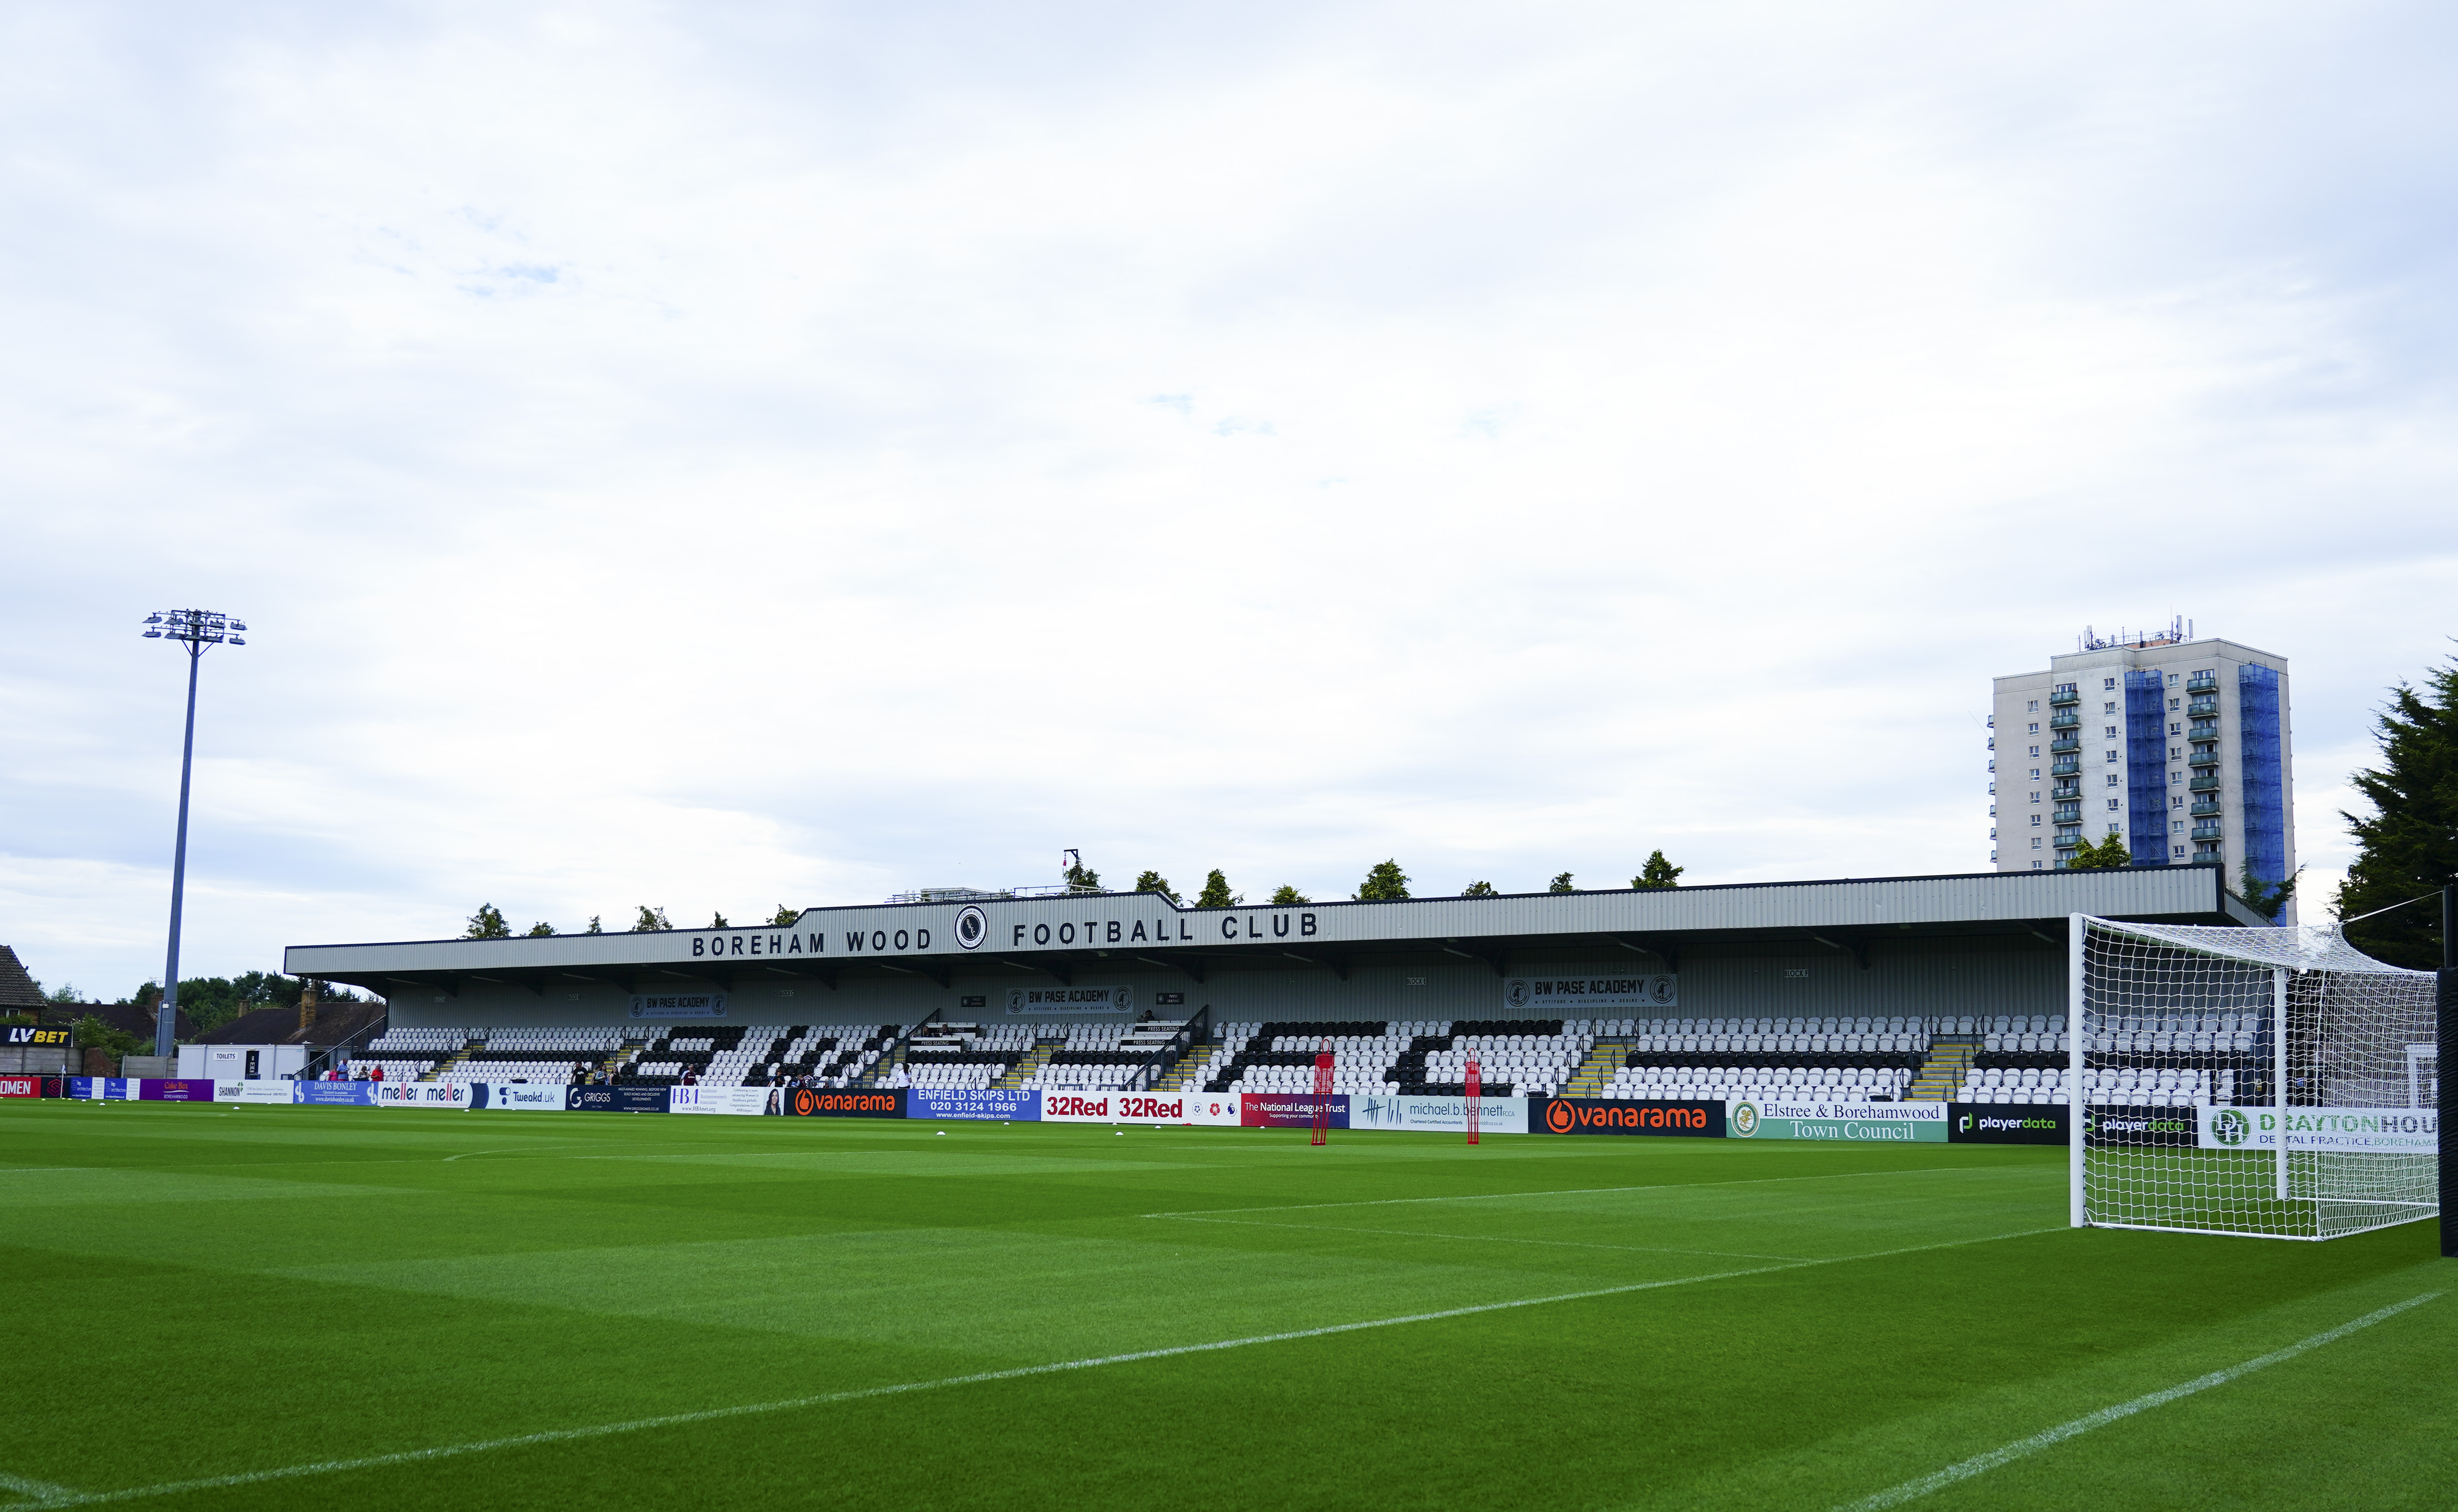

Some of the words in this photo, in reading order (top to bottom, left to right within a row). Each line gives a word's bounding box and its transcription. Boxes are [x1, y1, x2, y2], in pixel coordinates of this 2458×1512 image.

[1014, 918, 1193, 946] FOOTBALL
[1222, 913, 1317, 940] CLUB
[693, 933, 824, 956] BOREHAM
[847, 929, 930, 952] WOOD
[1535, 982, 1553, 995] BW
[1556, 981, 1585, 994] PASE
[1589, 979, 1644, 994] ACADEMY
[647, 997, 658, 1008] BW
[660, 997, 676, 1008] PASE
[678, 997, 710, 1008] ACADEMY
[1029, 992, 1042, 1003] BW
[1045, 991, 1065, 1002] PASE
[1068, 990, 1110, 1002] ACADEMY
[0, 1081, 31, 1095] OMEN
[219, 1087, 240, 1096] SHANNON
[333, 1083, 357, 1091] BONLEY
[382, 1083, 418, 1100] meller
[427, 1083, 464, 1101] meller
[513, 1092, 555, 1102] Tweakd.uk
[584, 1092, 611, 1102] GRIGGS
[815, 1095, 895, 1111] vanarama
[919, 1090, 967, 1100] ENFIELD
[970, 1091, 1004, 1100] SKIPS
[1008, 1091, 1030, 1101] LTD
[930, 1101, 951, 1110] 020
[955, 1102, 984, 1111] 3124
[988, 1102, 1017, 1111] 1966
[1047, 1096, 1108, 1116] 32Red
[1119, 1097, 1182, 1118] 32Red
[1245, 1102, 1258, 1111] The
[1260, 1102, 1293, 1111] National
[1325, 1103, 1346, 1113] Trust
[1763, 1103, 1811, 1118] Elstree
[1816, 1104, 1829, 1118] &
[1833, 1105, 1940, 1120] Borehamwood
[1577, 1107, 1707, 1128] vanarama
[1979, 1116, 2056, 1131] playerdata
[1790, 1121, 1838, 1139] Town
[1845, 1122, 1915, 1140] Council
[2103, 1118, 2184, 1133] playerdata
[2260, 1135, 2306, 1144] DETAL
